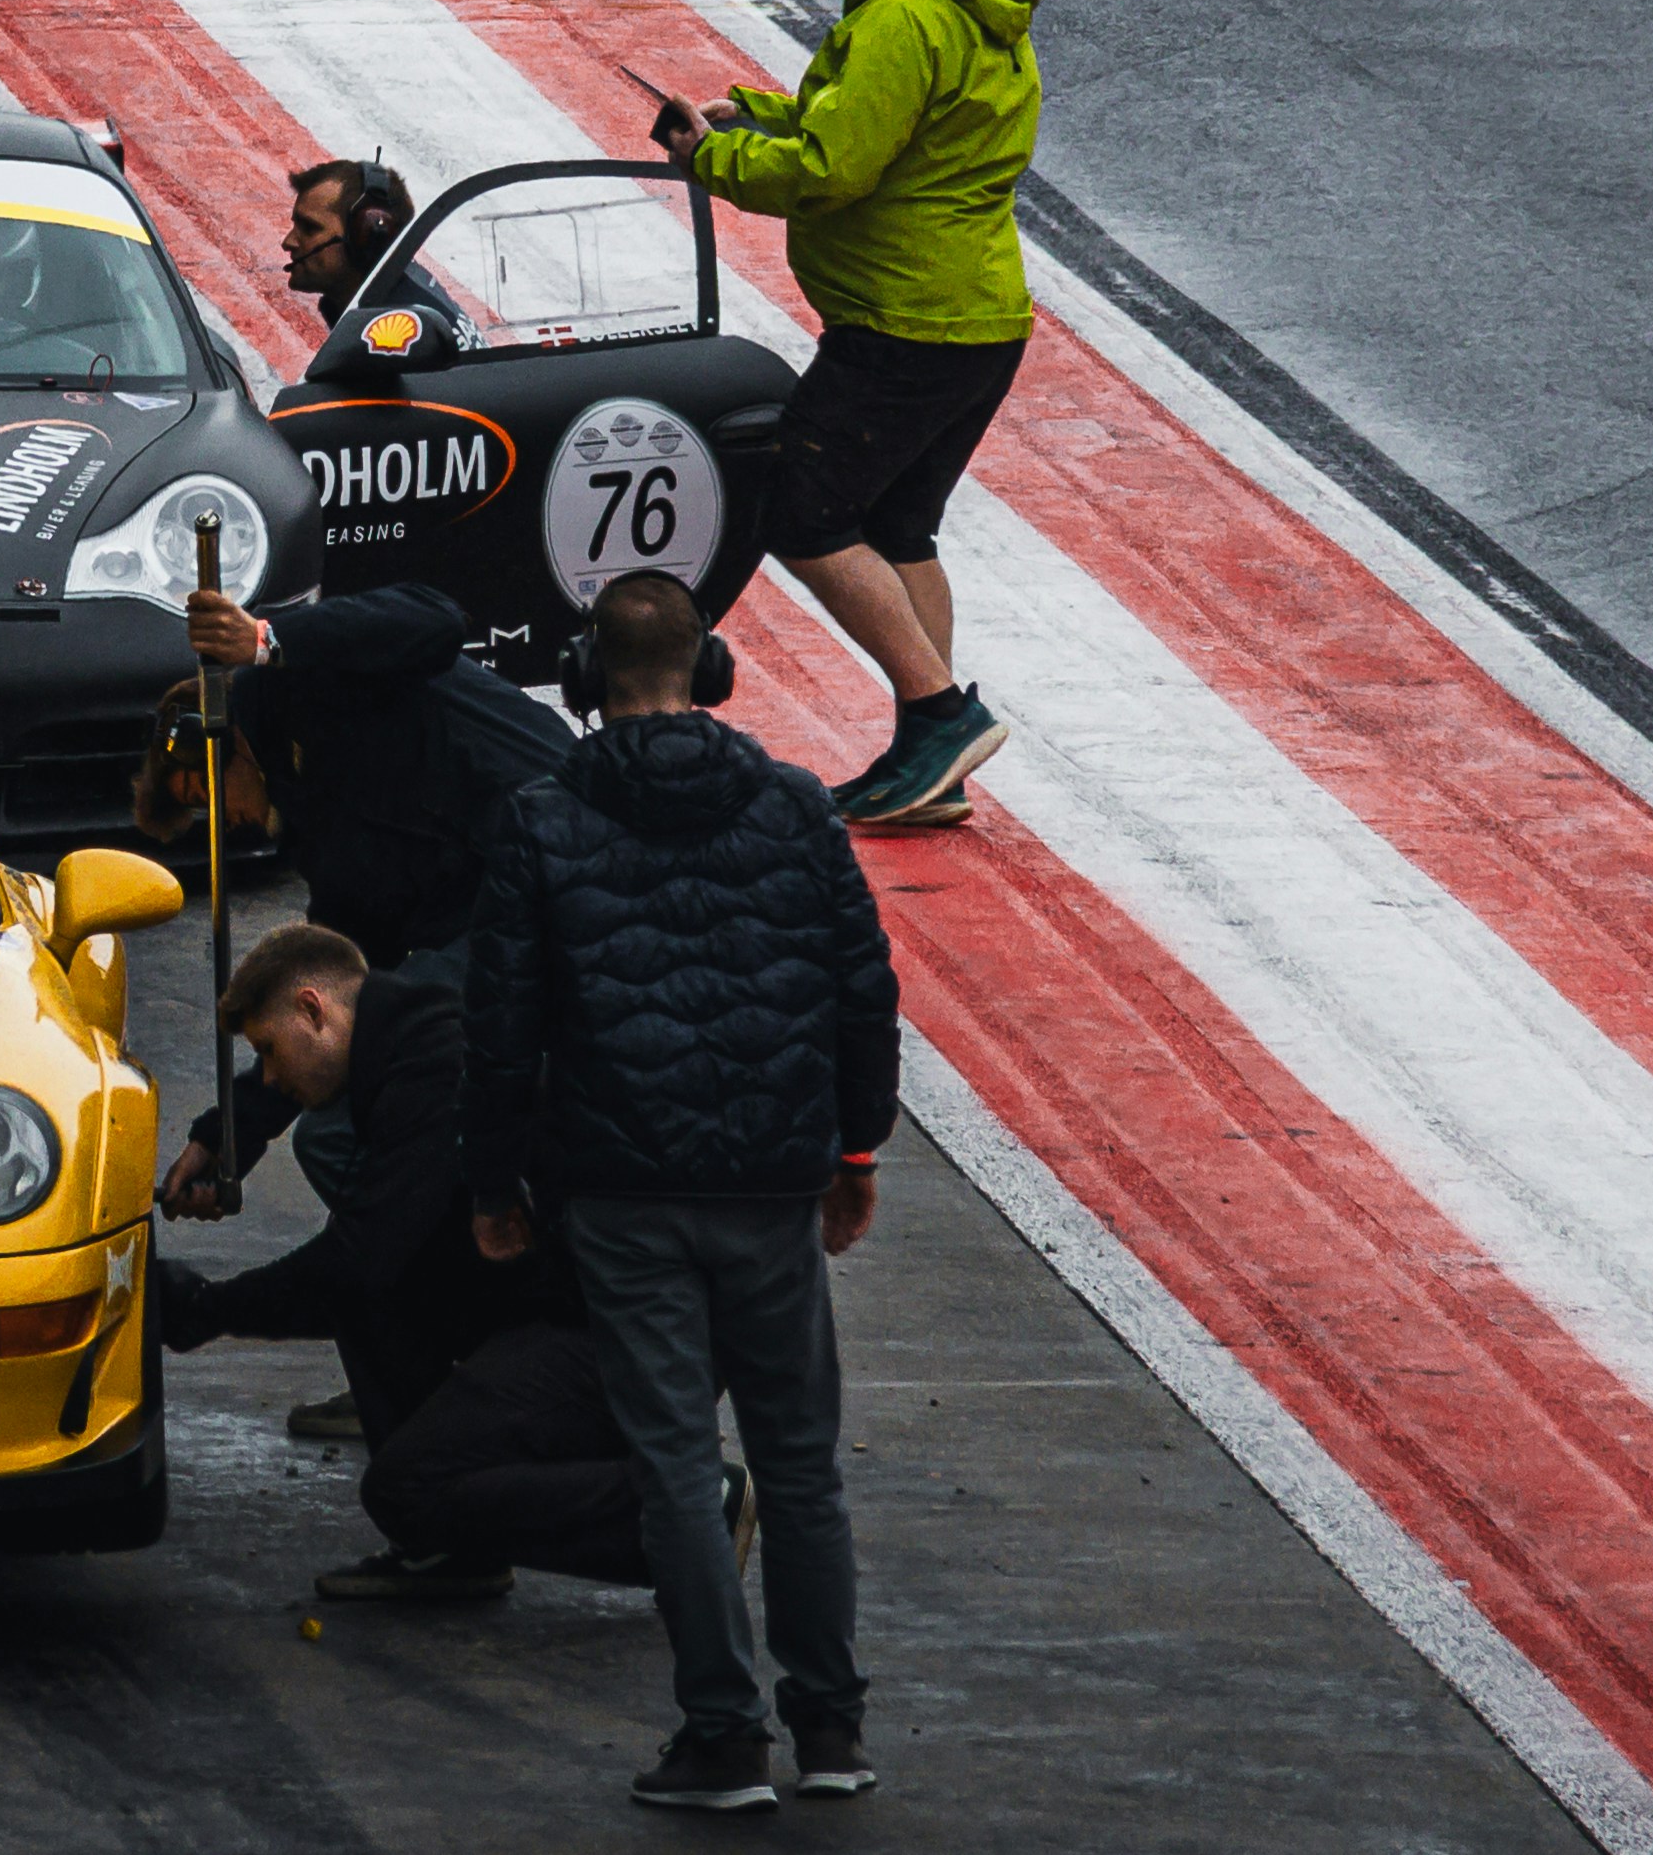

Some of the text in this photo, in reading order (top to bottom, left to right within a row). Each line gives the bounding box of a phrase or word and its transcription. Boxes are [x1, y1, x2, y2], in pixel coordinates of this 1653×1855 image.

[302, 435, 486, 508] DHOLM
[326, 522, 405, 545] EASING
[588, 466, 677, 562] 76
